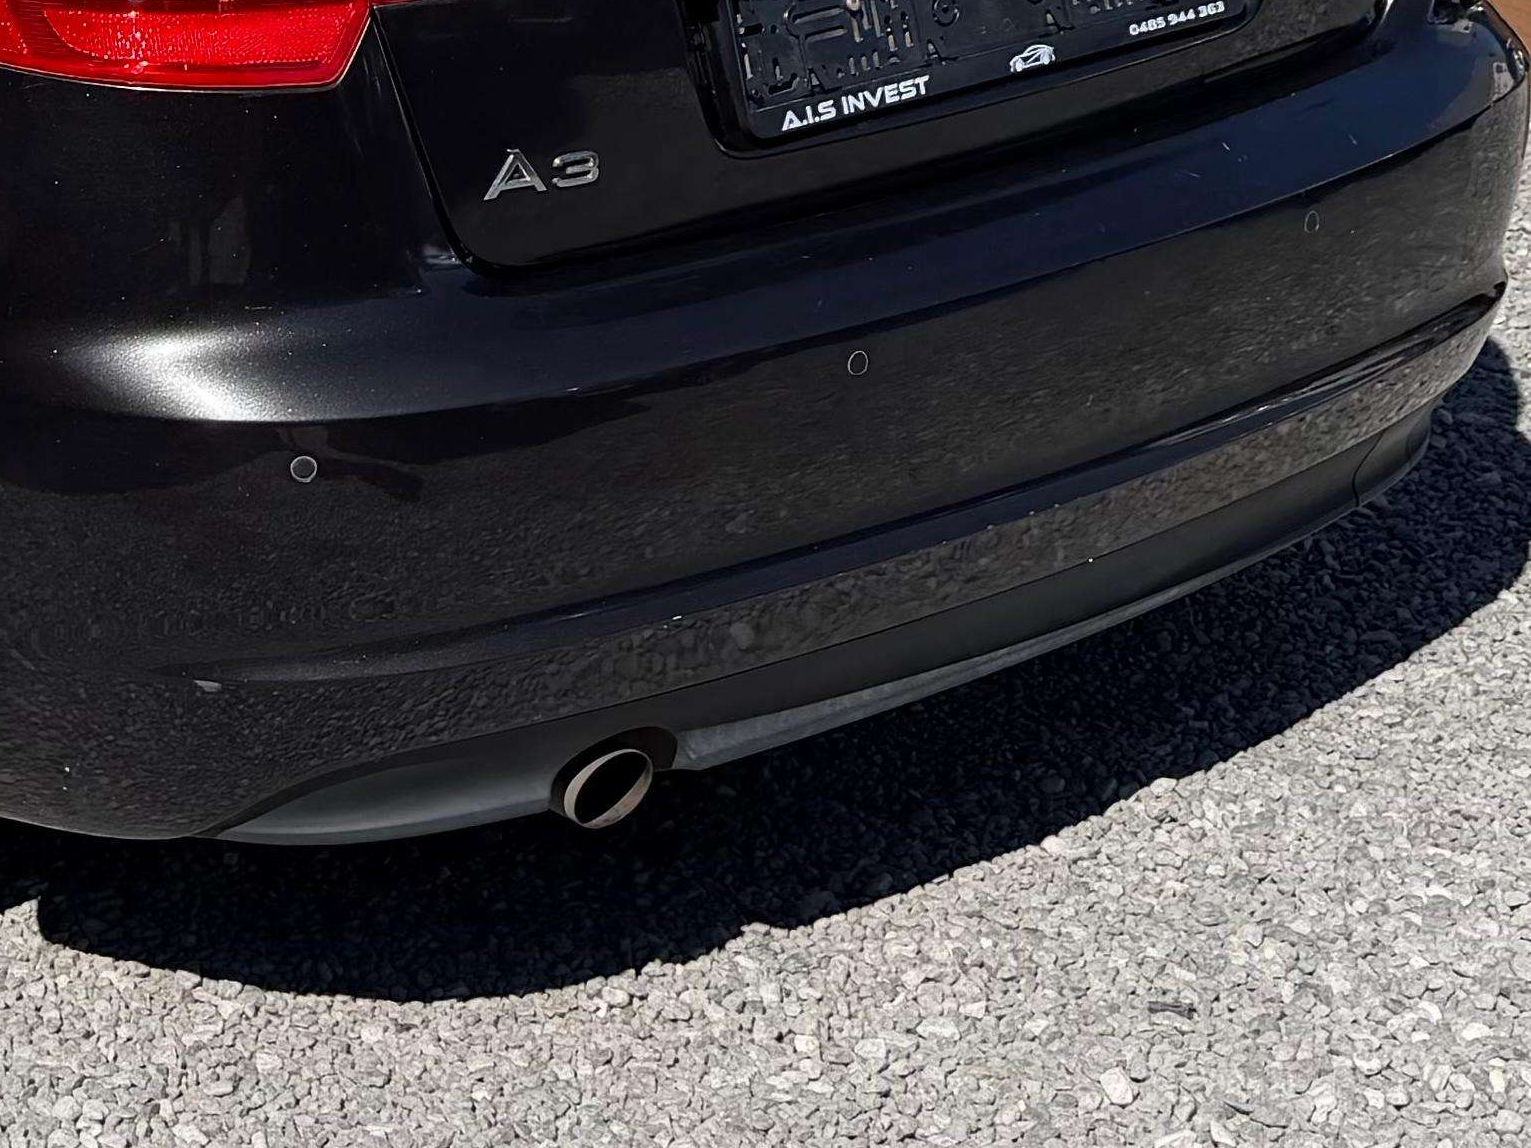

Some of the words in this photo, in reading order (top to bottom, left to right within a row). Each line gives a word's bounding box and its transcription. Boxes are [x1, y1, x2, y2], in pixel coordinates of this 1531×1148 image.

[1129, 16, 1167, 36] 0485
[781, 99, 837, 132] A.I.S
[841, 74, 930, 115] INVEST
[483, 148, 601, 201] A3
